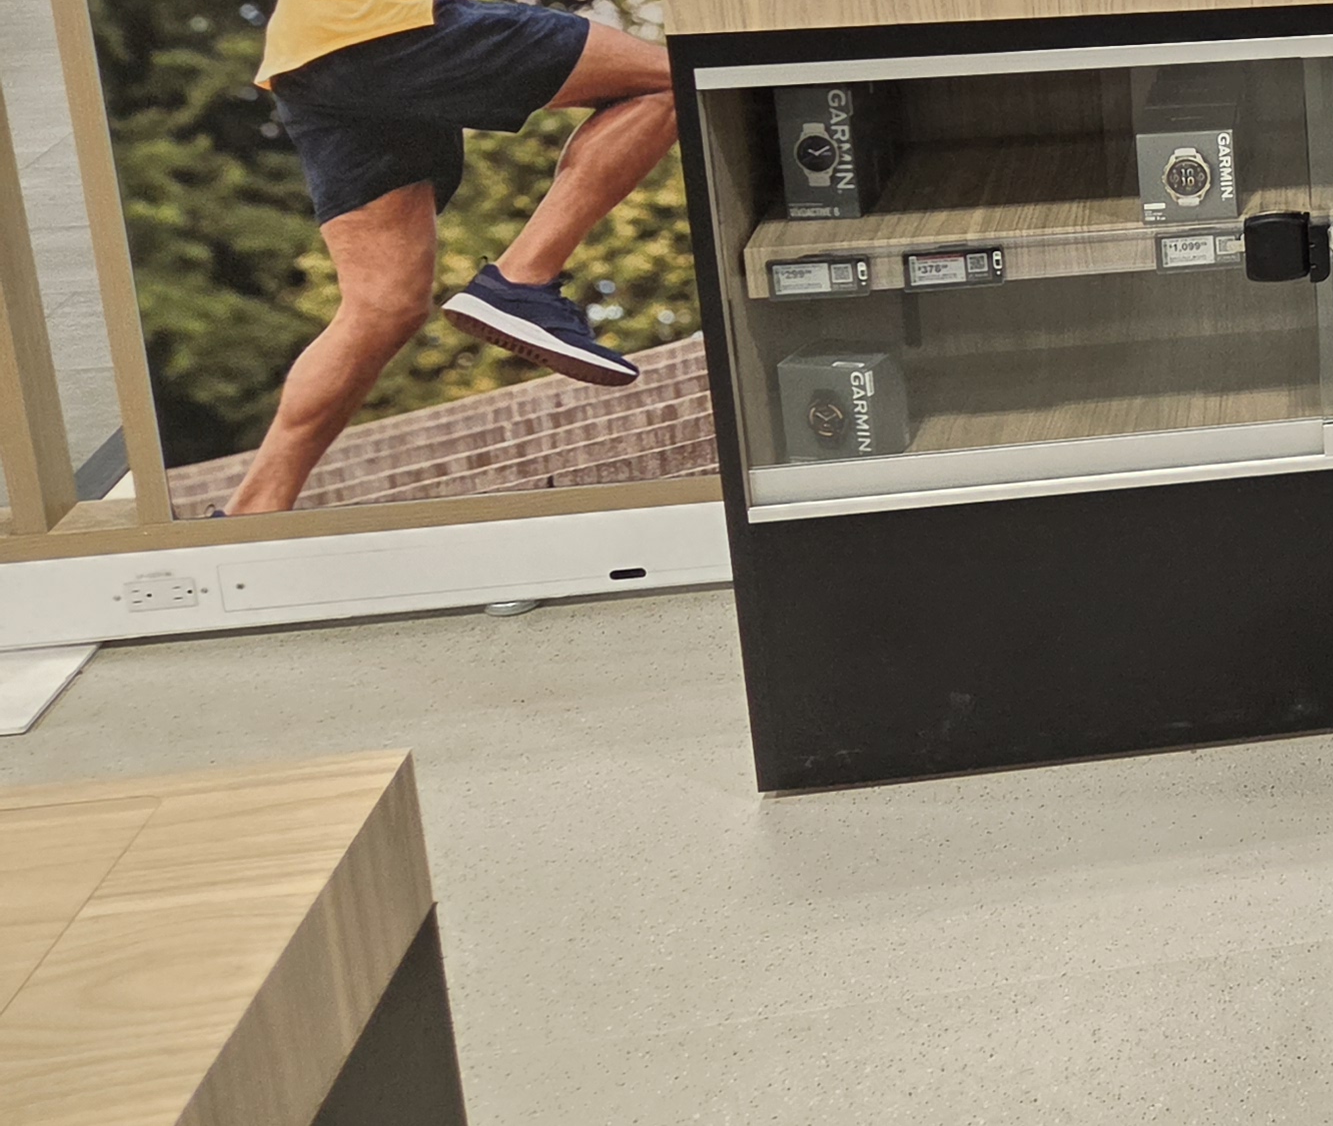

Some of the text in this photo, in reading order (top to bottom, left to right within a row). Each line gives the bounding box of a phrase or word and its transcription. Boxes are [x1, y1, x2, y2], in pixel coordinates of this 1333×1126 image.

[828, 89, 855, 190] GARMIN
[1217, 132, 1234, 199] GARMIN
[850, 371, 872, 452] GARMIN
